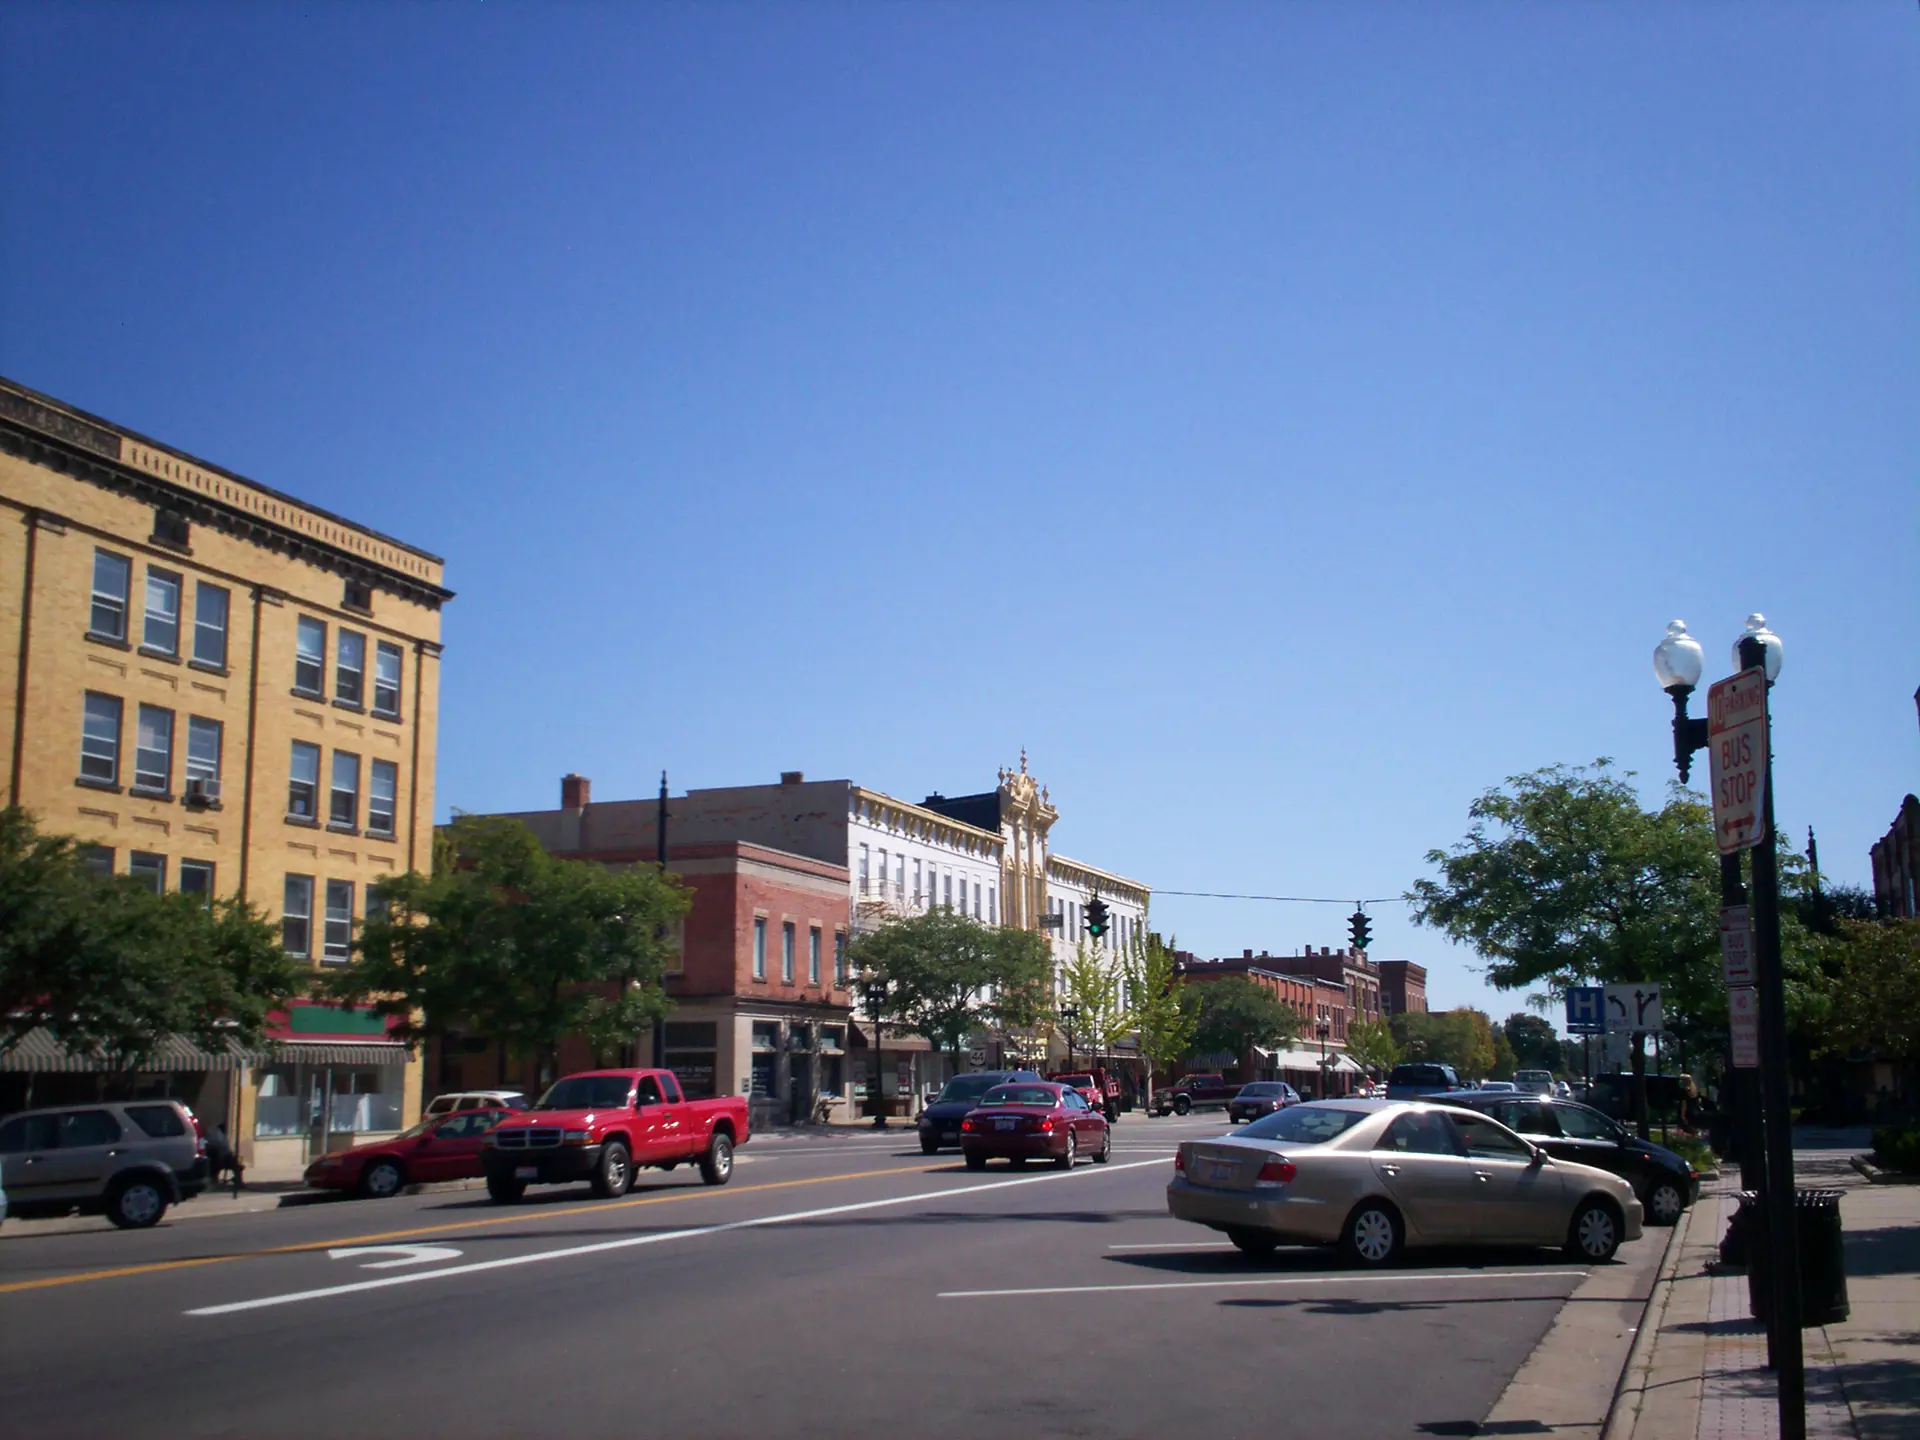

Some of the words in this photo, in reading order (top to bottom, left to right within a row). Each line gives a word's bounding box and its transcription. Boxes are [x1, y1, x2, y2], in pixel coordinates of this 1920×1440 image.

[1721, 733, 1751, 769] BUS
[1720, 769, 1757, 809] STOP
[1727, 932, 1744, 948] BUS
[1727, 950, 1747, 965] STOP
[1574, 991, 1597, 1018] H
[972, 1052, 984, 1061] 44
